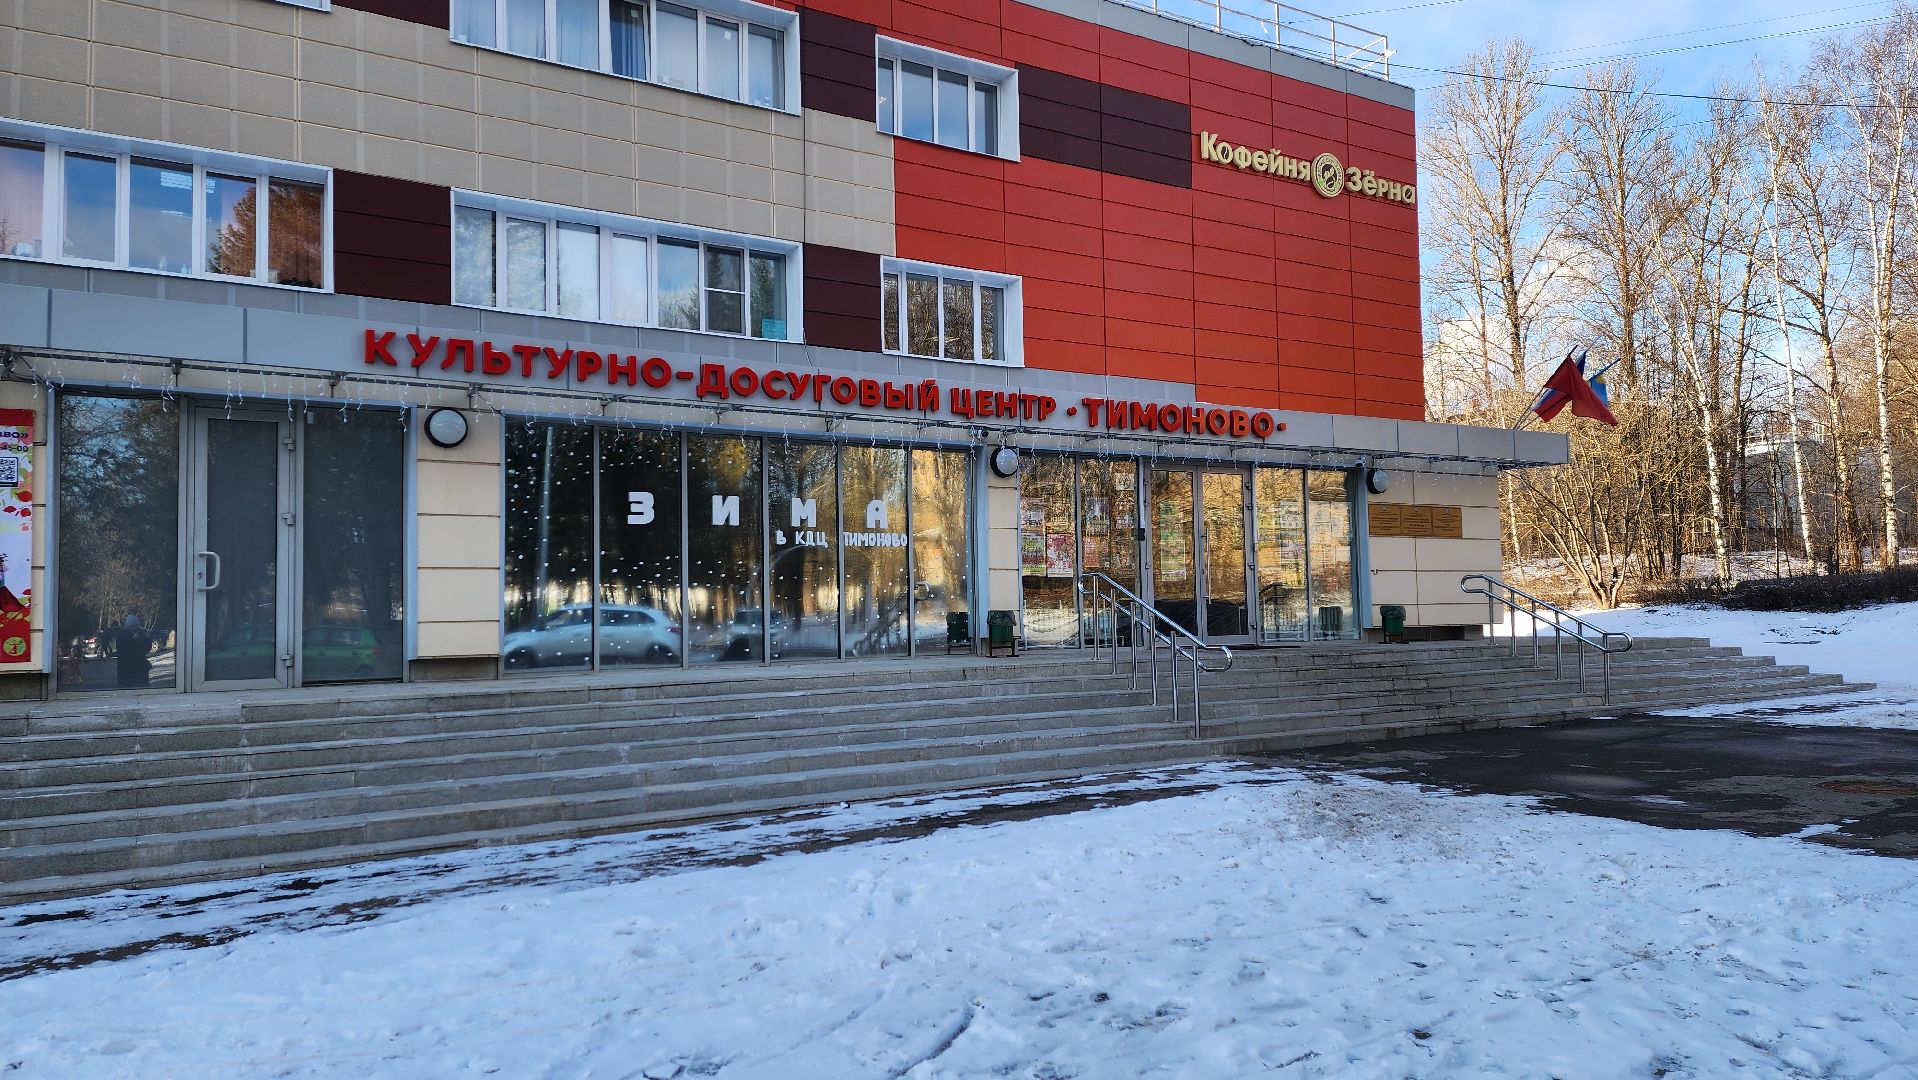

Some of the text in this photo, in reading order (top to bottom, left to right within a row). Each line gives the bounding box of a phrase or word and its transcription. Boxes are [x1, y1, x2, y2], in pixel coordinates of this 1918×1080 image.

[1200, 130, 1311, 181] Кофейня
[1345, 166, 1416, 204] Зёрна
[364, 328, 940, 412] КУЛЬТУРНО-ДОСУГОВЫЙ
[950, 387, 1057, 420] ЦЕНТР
[795, 531, 828, 548] КДЦ
[843, 532, 907, 547] ТИМОНОВО
